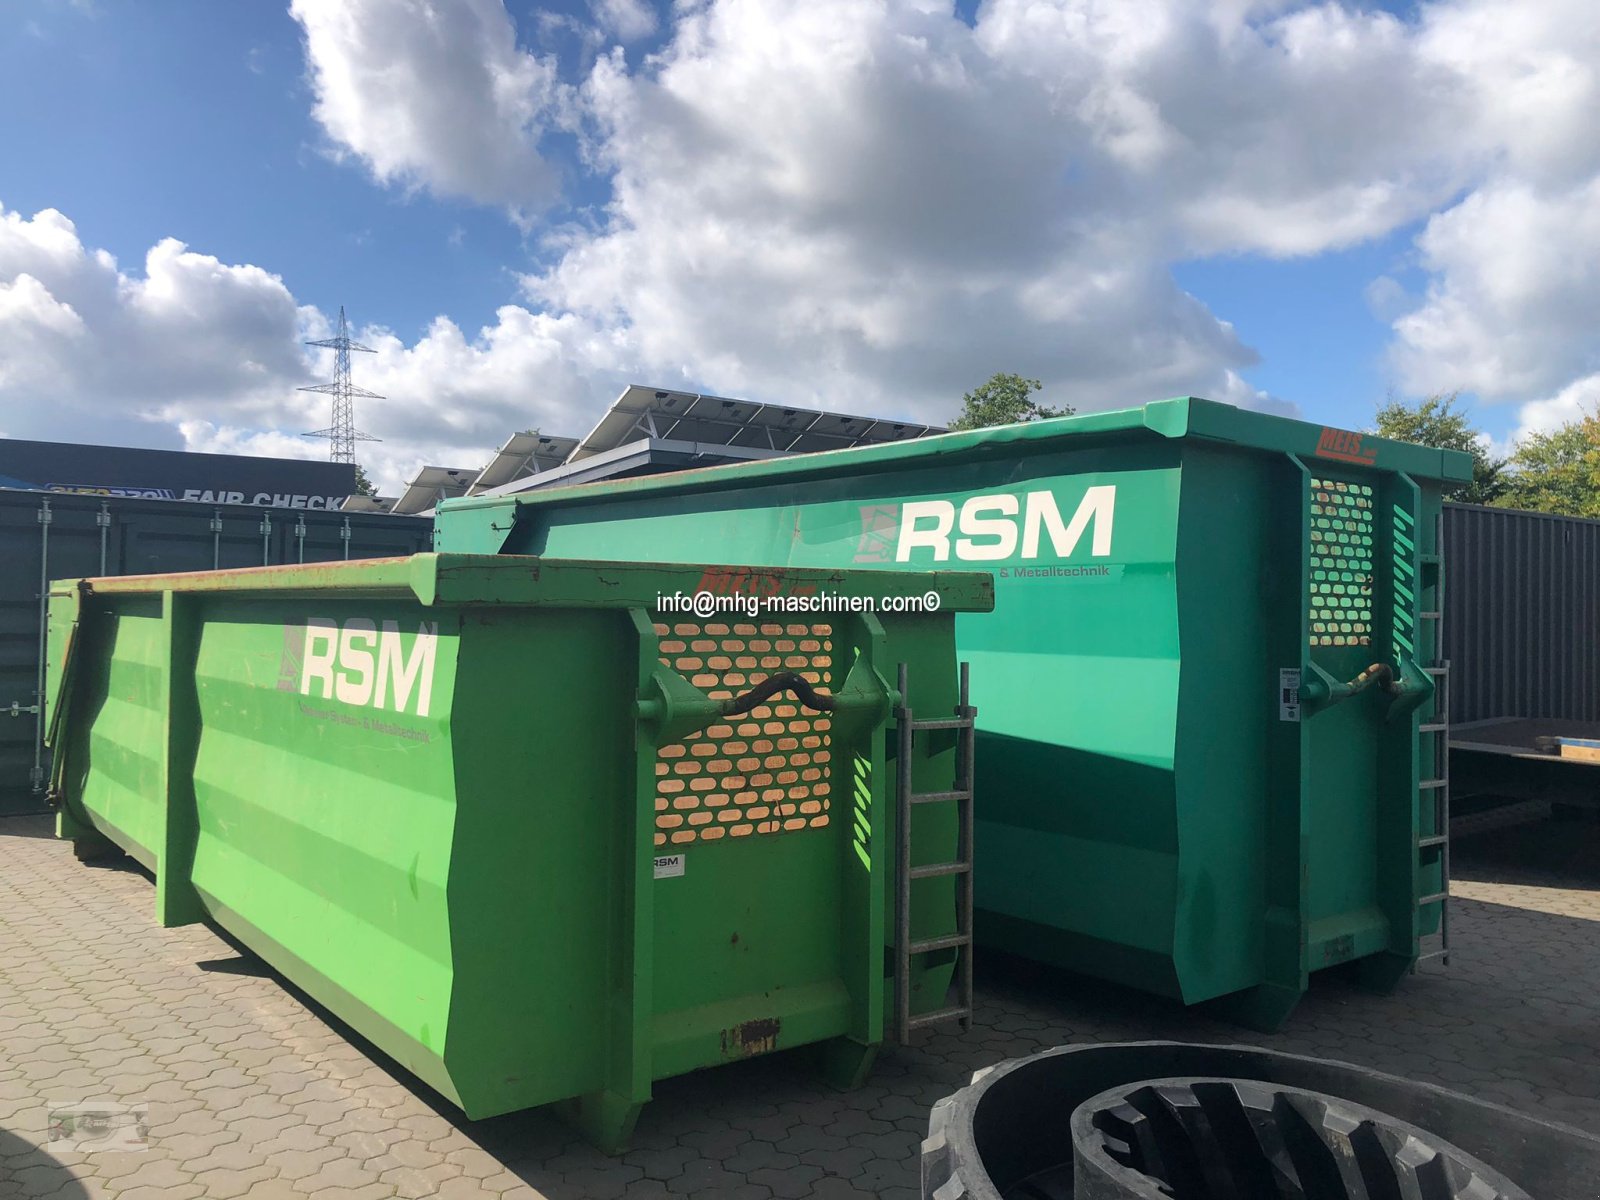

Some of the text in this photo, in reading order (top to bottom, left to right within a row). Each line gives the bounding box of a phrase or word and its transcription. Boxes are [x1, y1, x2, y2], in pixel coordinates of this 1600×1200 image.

[184, 489, 344, 510] FAIR CHECK
[895, 485, 1116, 563] RSM
[1014, 564, 1110, 578] Metalltechnik
[300, 617, 439, 718] RSM
